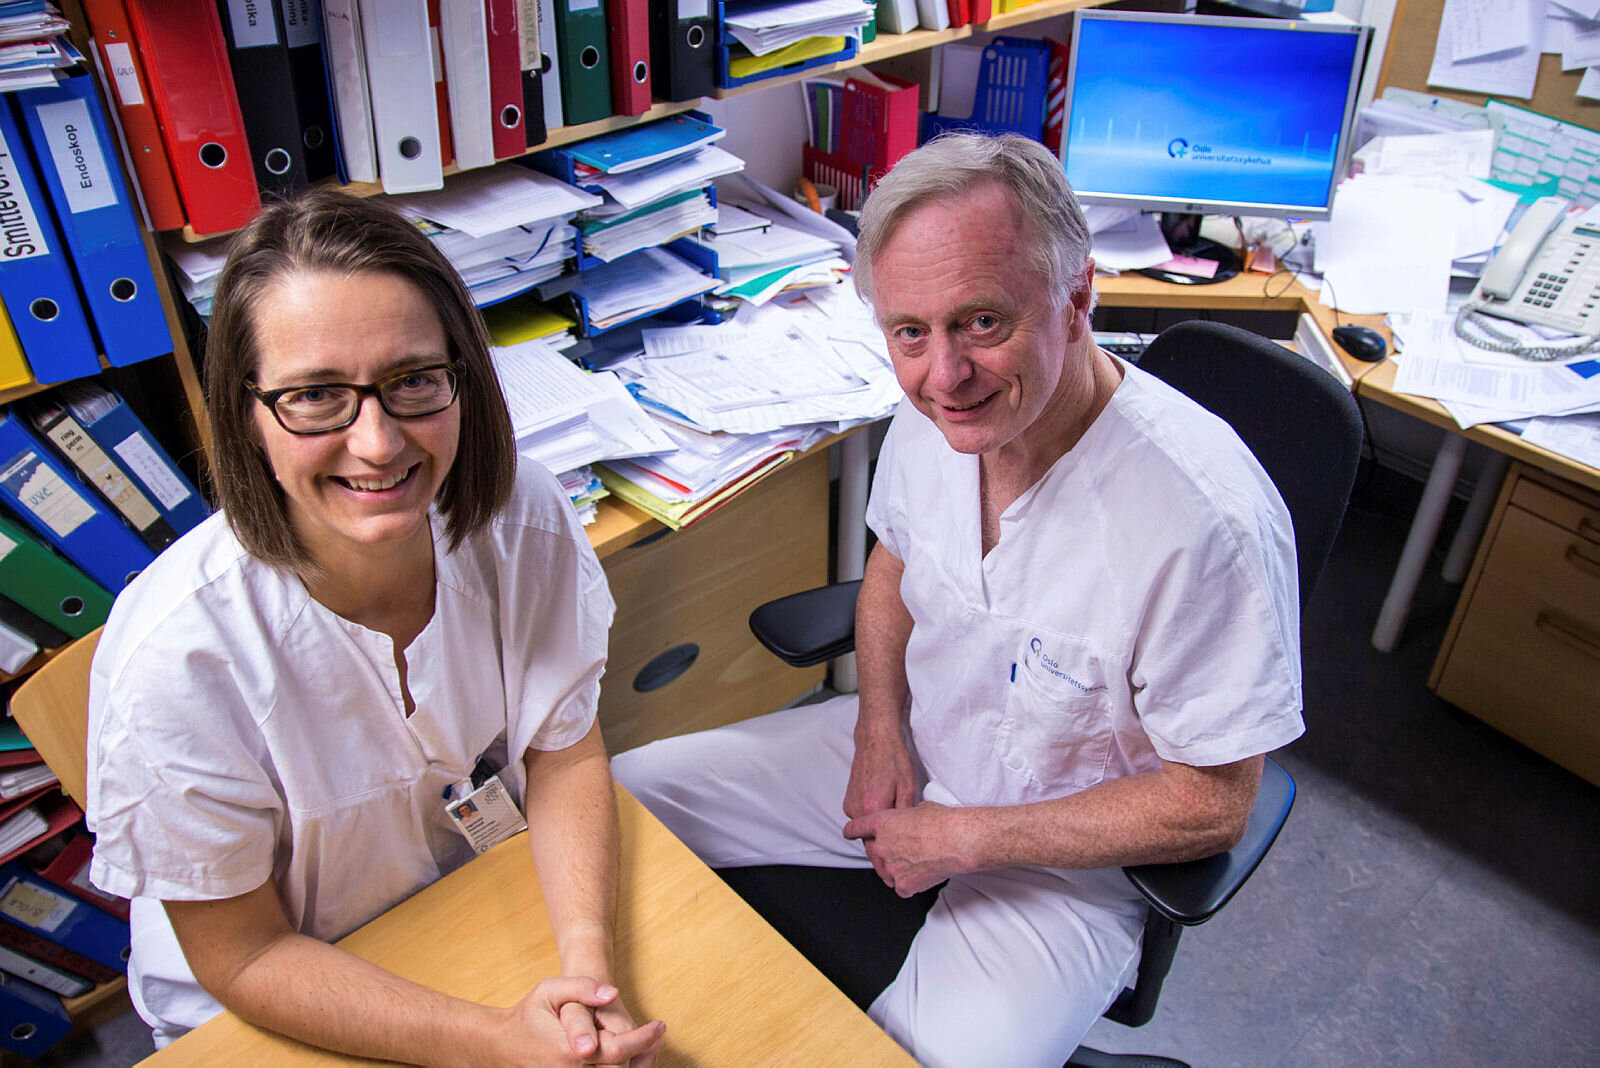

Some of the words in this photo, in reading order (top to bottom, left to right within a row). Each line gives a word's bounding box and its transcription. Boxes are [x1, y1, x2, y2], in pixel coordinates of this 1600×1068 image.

[288, 0, 297, 26] ning
[64, 124, 93, 189] Endoskop
[1192, 144, 1212, 153] Oslo
[1042, 654, 1059, 668] Oslo
